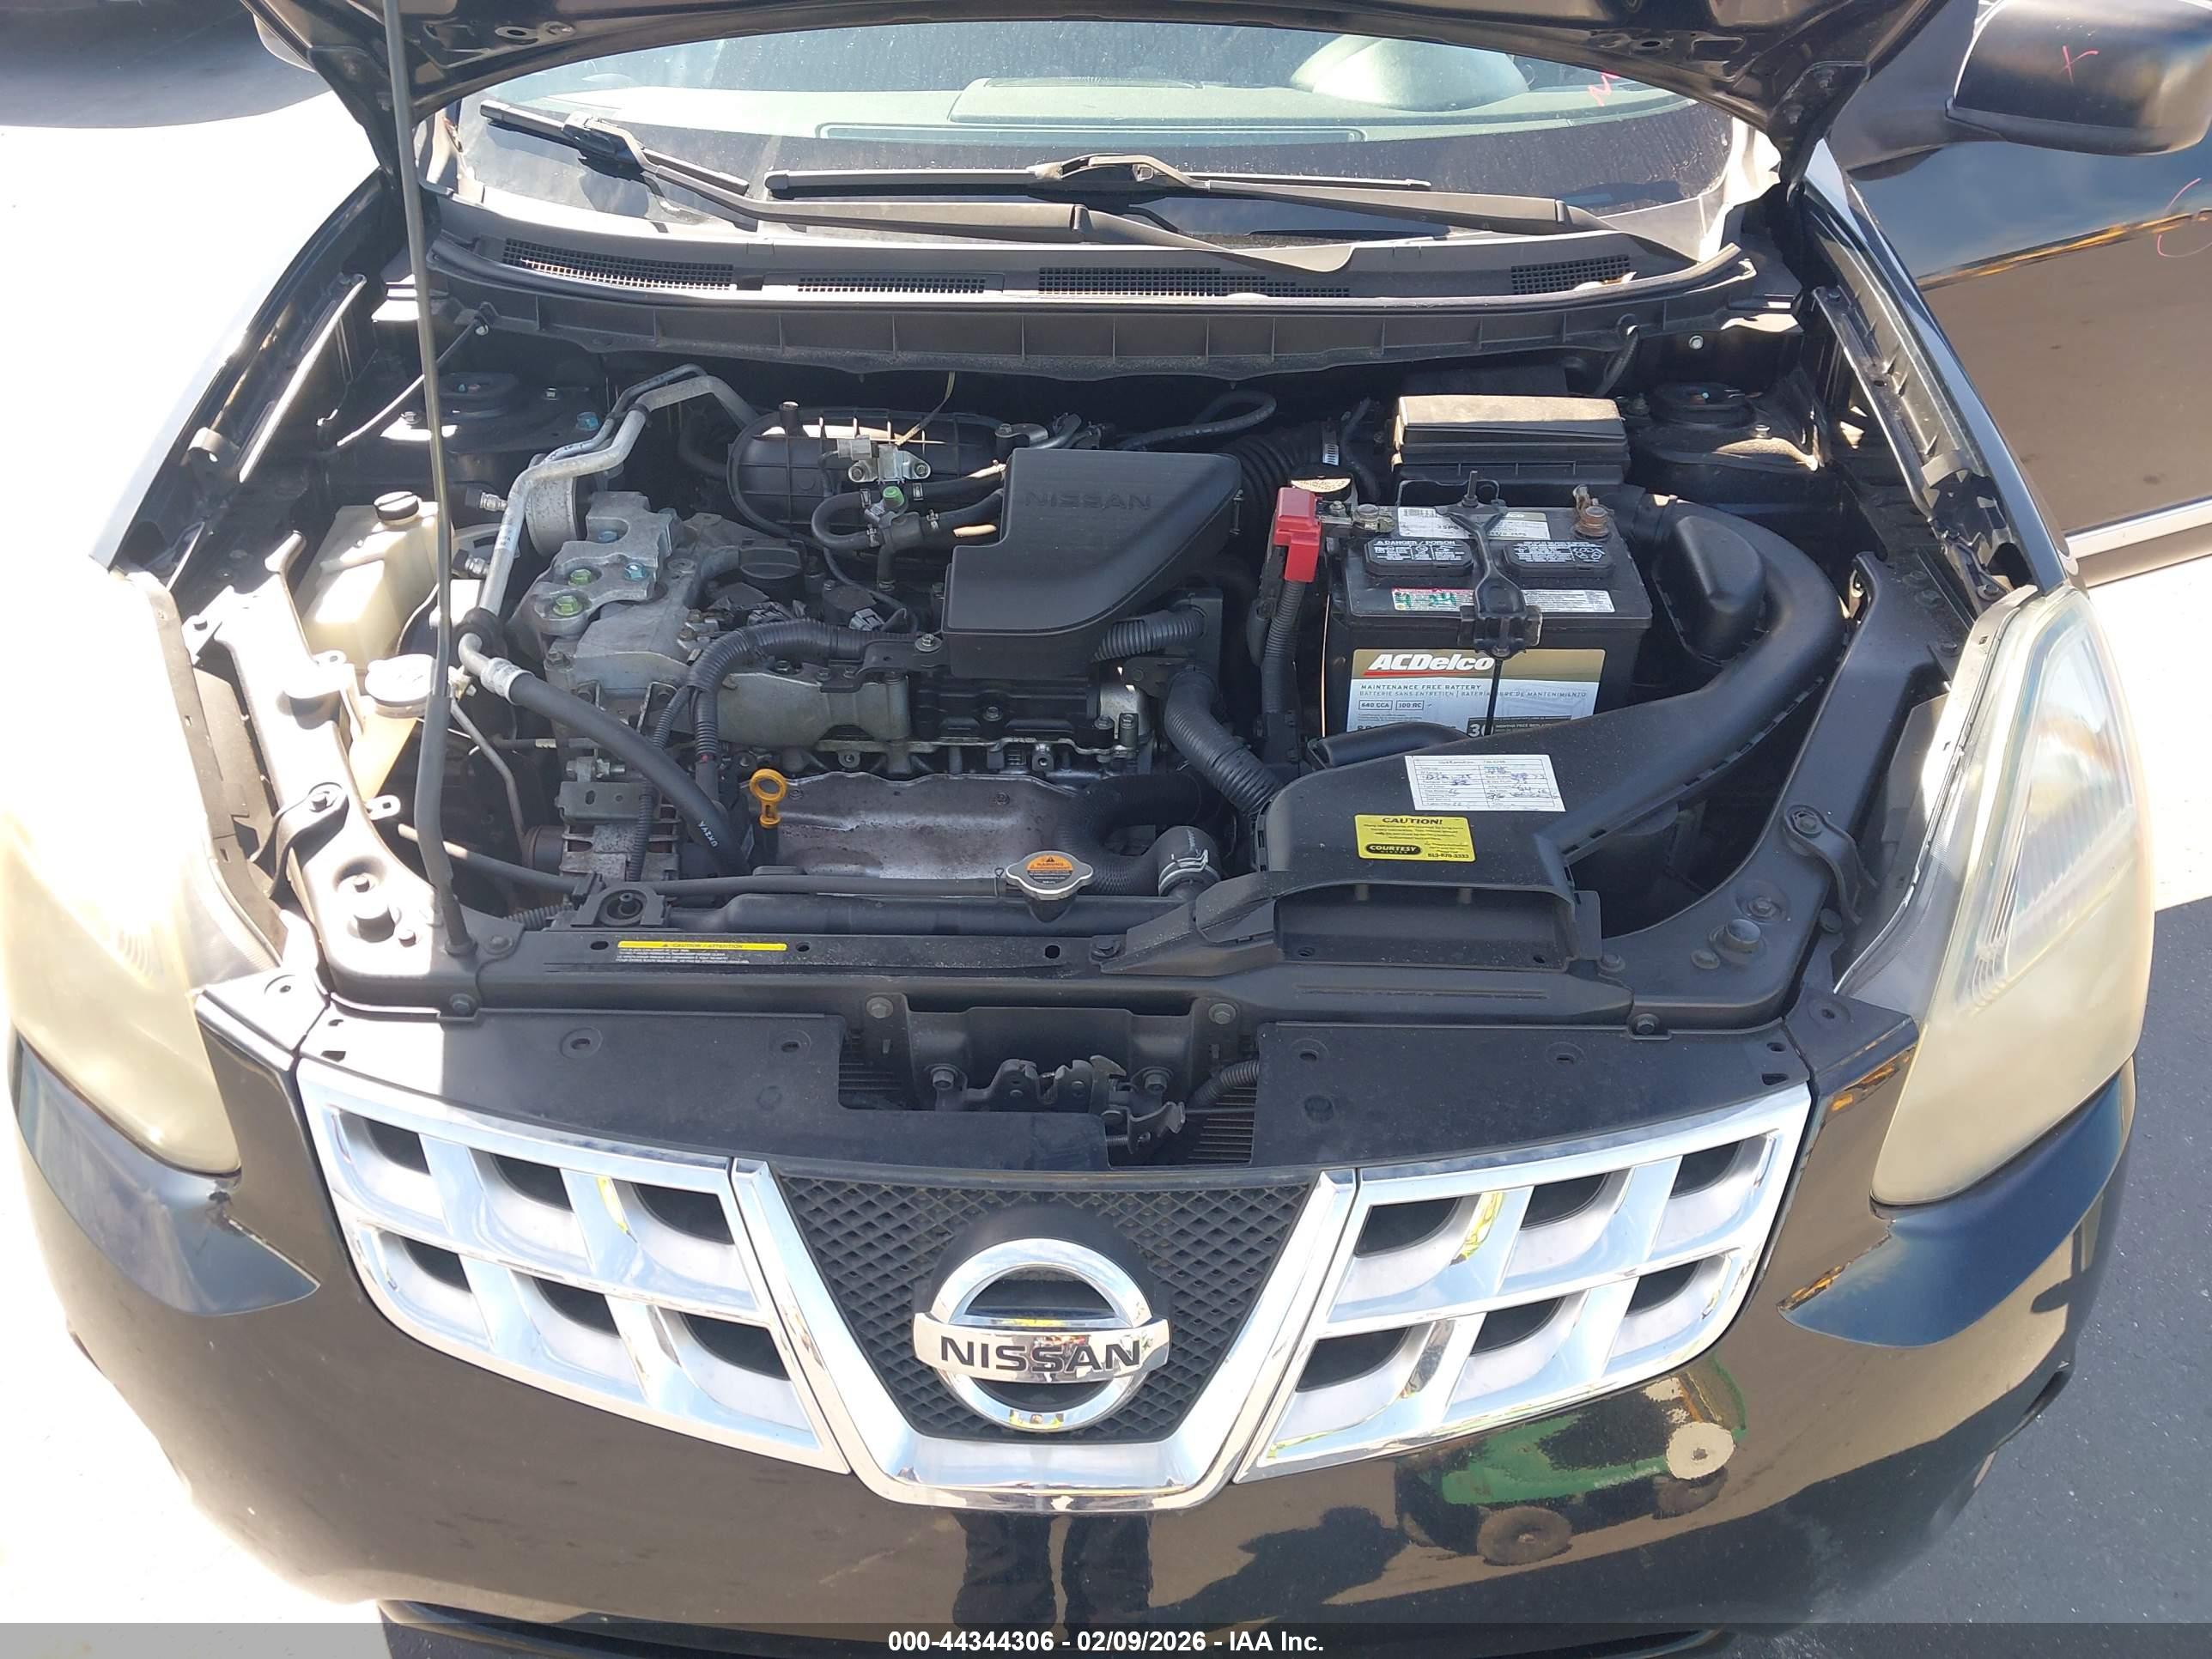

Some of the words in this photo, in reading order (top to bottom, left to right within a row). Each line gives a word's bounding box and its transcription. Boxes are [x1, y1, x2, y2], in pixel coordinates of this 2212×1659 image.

[1024, 491, 1152, 510] NISSAN
[1368, 653, 1495, 671] ACDelco
[940, 1335, 1140, 1373] NISSAN
